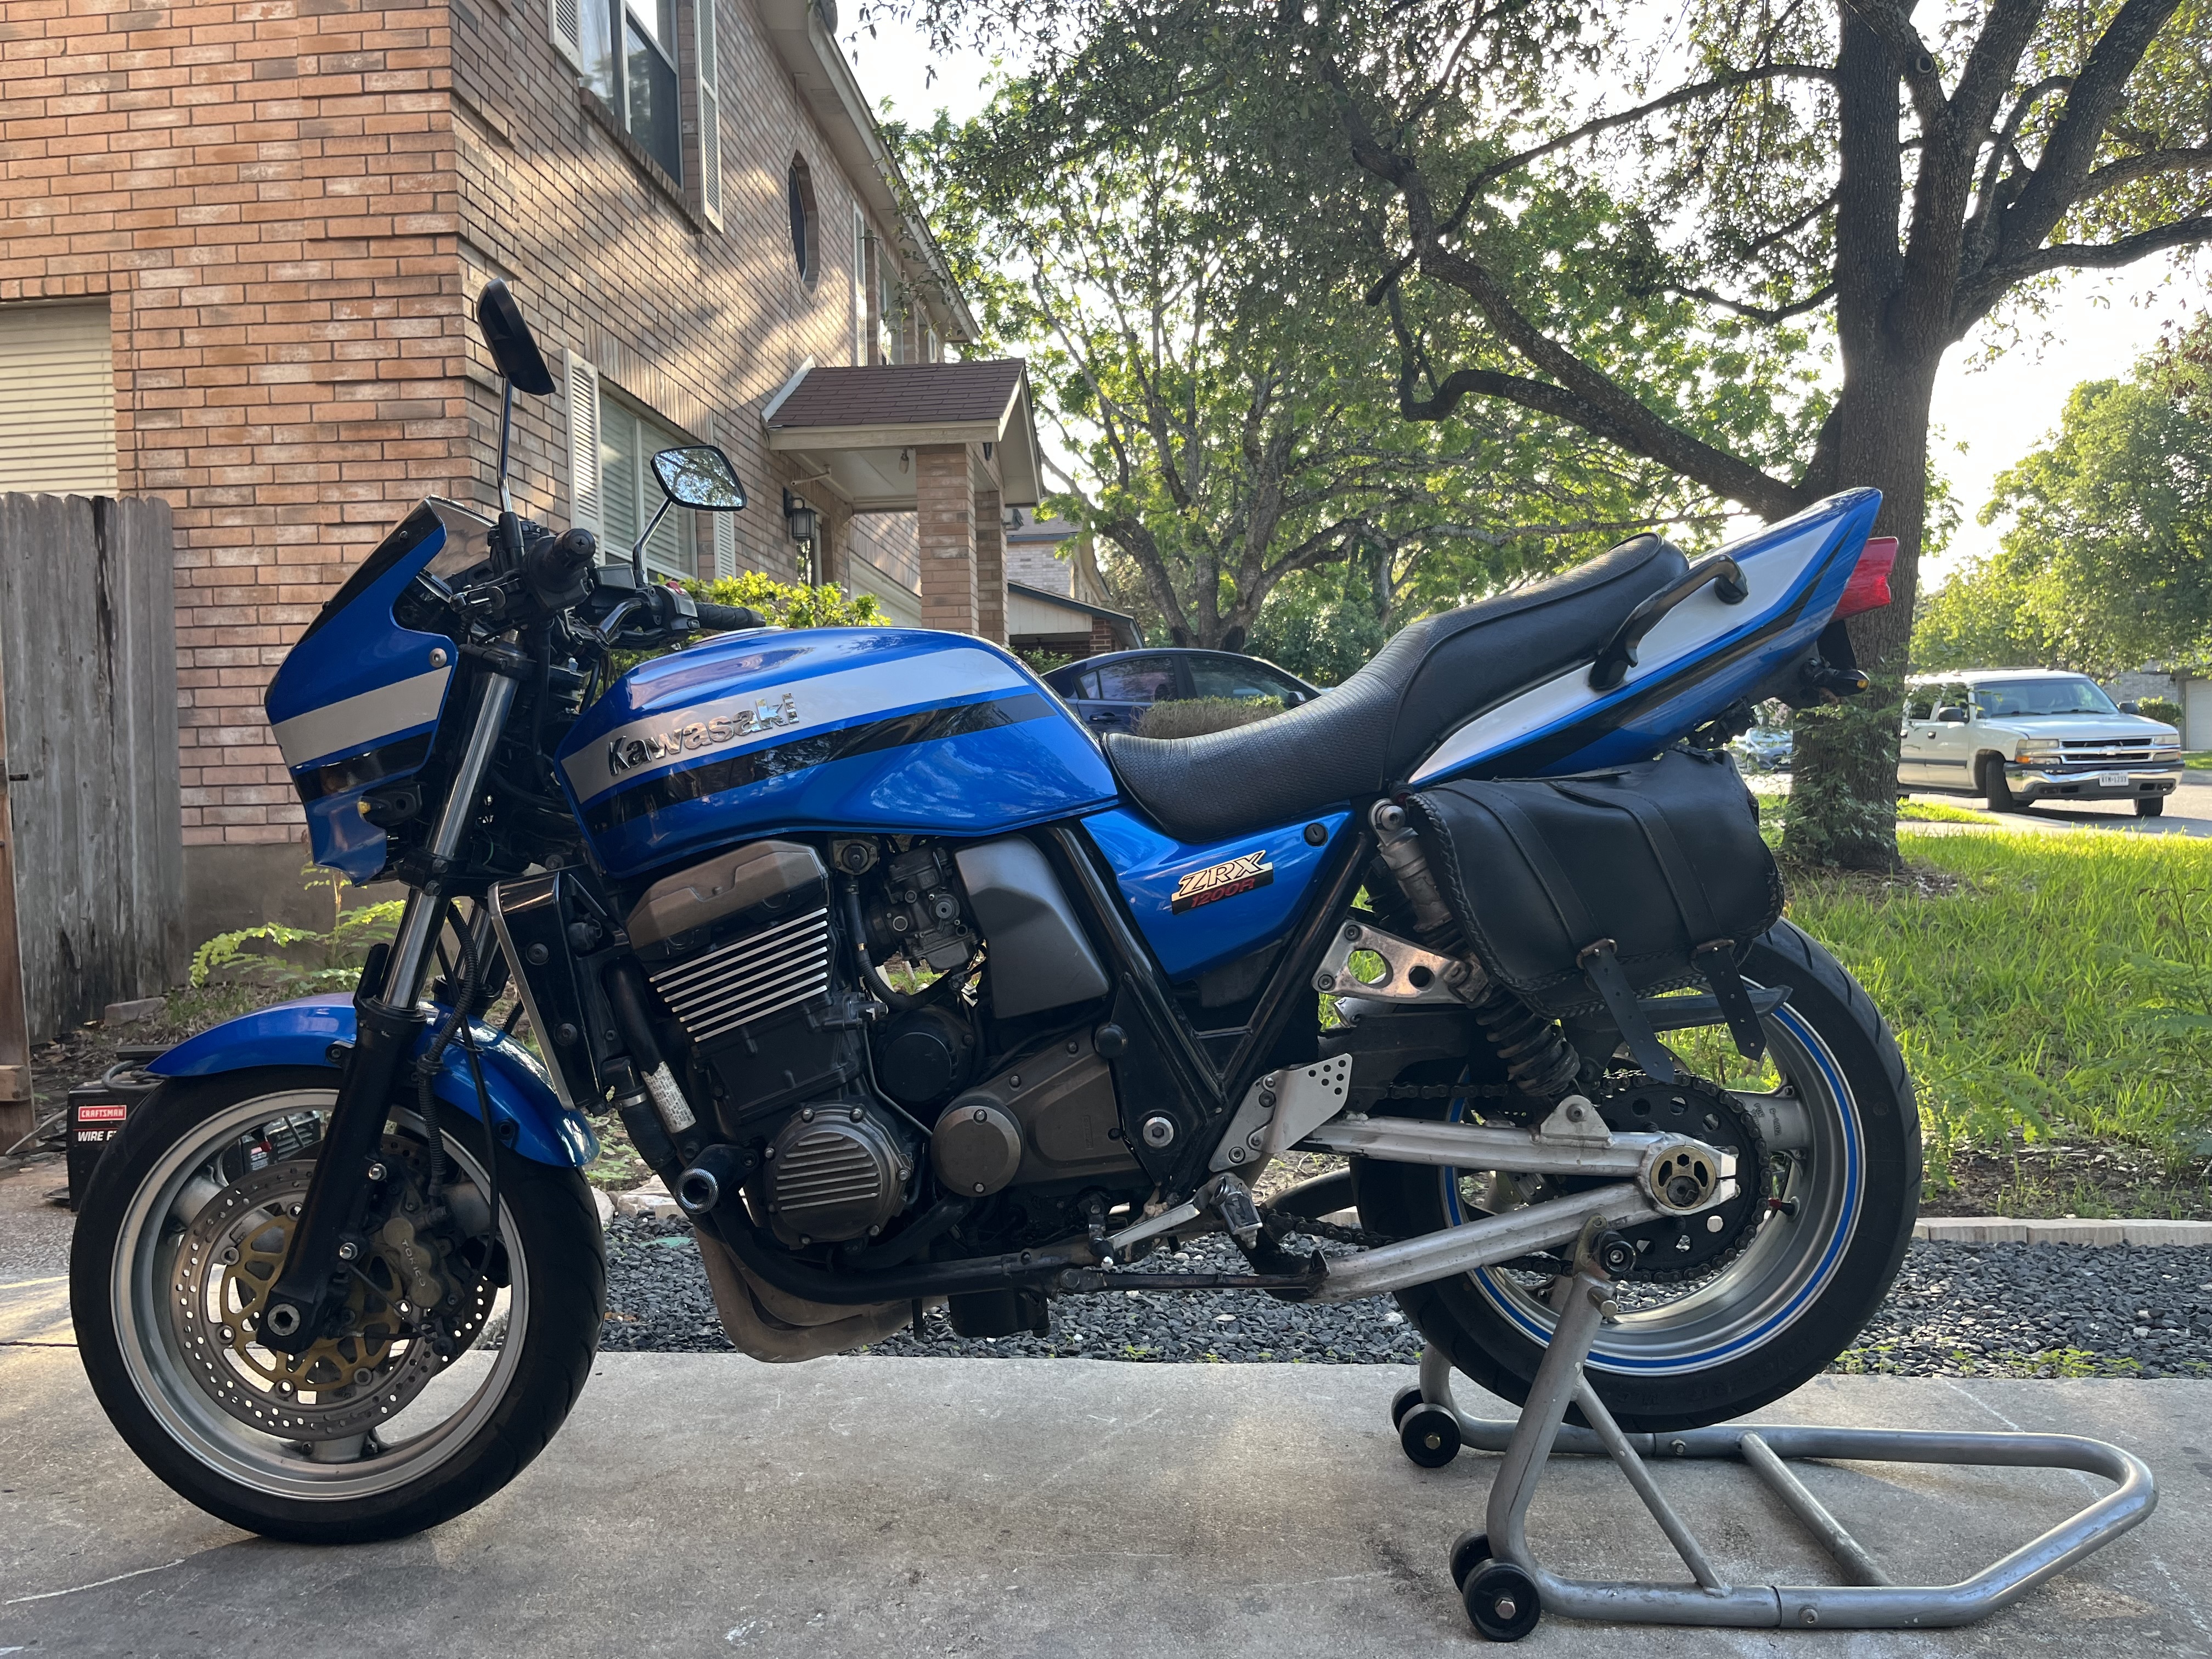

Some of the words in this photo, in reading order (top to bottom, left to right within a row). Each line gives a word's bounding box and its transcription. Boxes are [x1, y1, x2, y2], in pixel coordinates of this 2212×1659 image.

[609, 693, 800, 776] Kawasaki
[1179, 851, 1265, 897] ZRX
[1190, 878, 1255, 908] 1200R
[81, 1109, 124, 1118] CRAFTSMAN
[78, 1131, 104, 1142] WIRE
[106, 1130, 117, 1141] F
[402, 1238, 426, 1287] TOKICO
